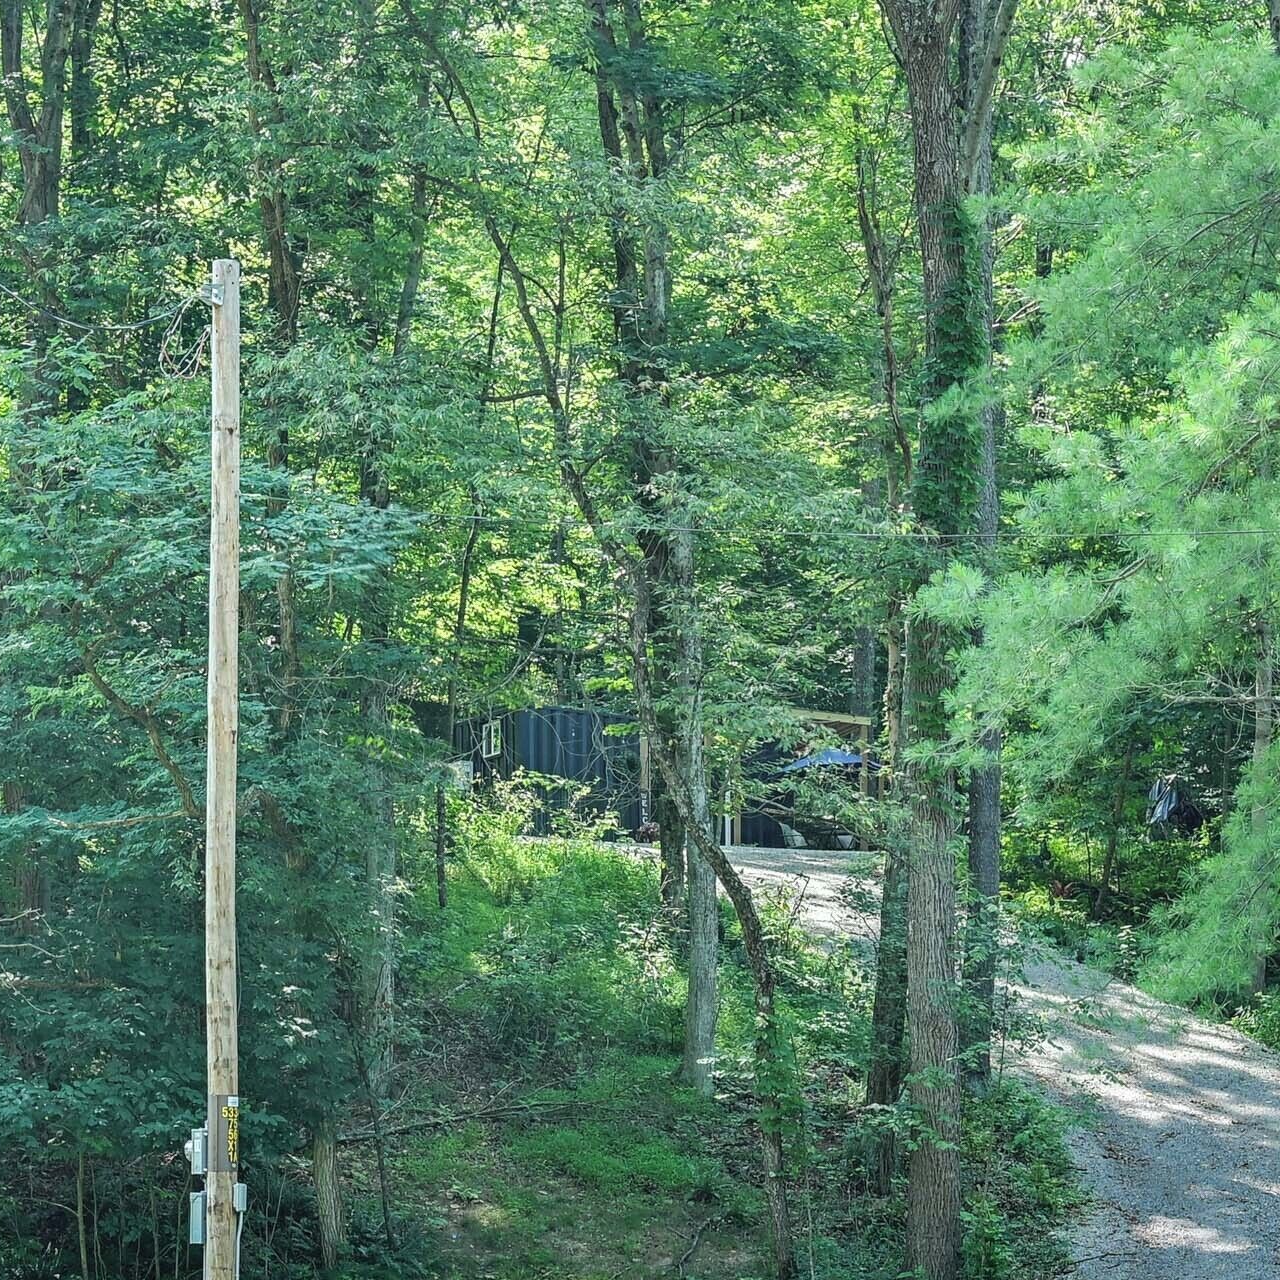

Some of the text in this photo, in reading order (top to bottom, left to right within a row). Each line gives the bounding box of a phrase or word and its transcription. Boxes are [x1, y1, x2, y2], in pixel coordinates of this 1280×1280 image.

[222, 1106, 238, 1118] 533
[228, 1118, 238, 1129] 75
[228, 1129, 238, 1140] 56
